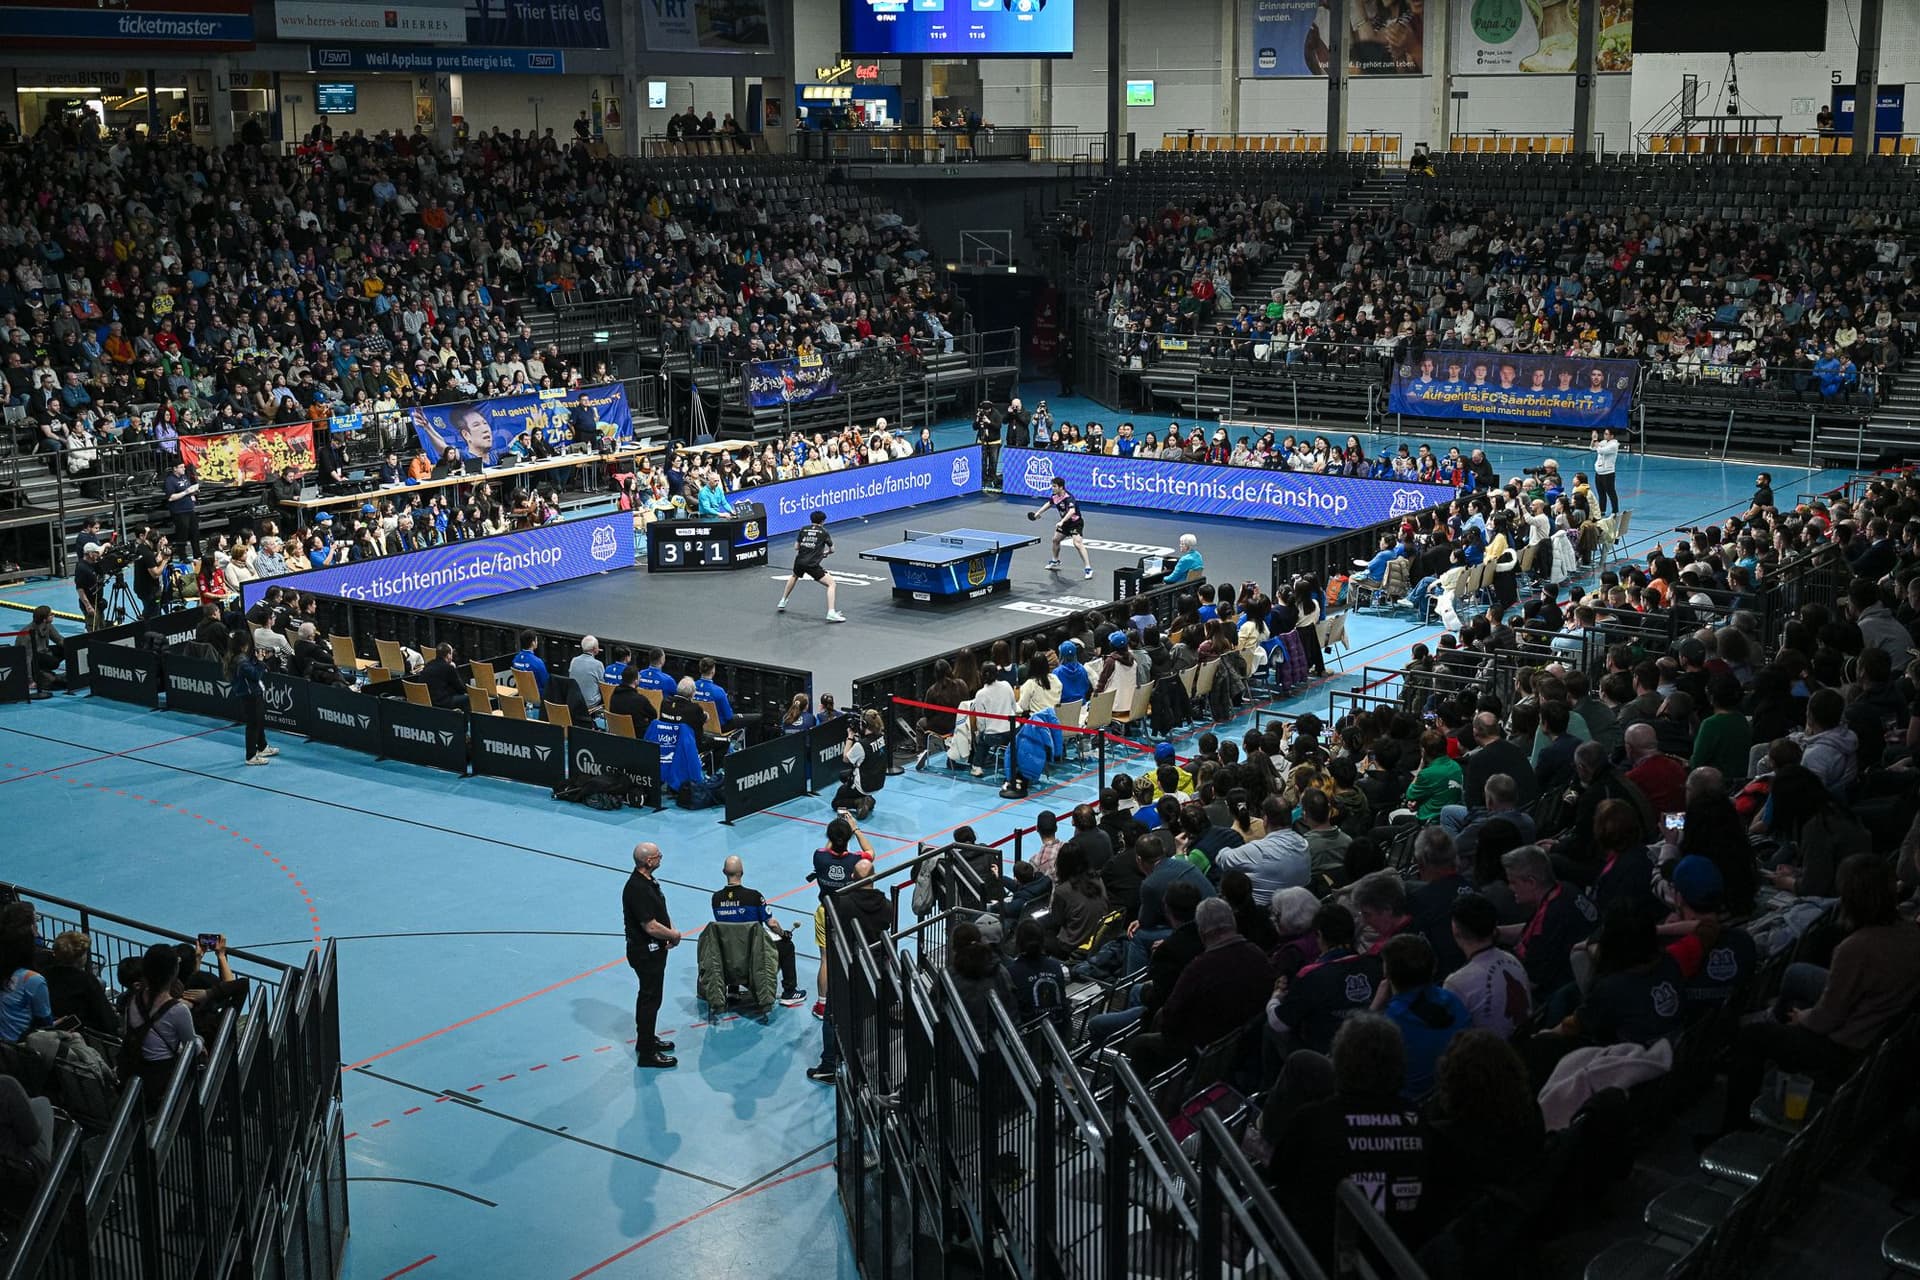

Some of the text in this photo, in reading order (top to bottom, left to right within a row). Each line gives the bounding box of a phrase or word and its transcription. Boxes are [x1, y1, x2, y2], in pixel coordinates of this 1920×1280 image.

[514, 4, 601, 22] Trier Eifel eG
[1259, 0, 1317, 13] Erinnerungen
[119, 15, 217, 36] ticketmaster
[281, 14, 449, 30] www.herres-sekt.com HERRES
[1474, 13, 1517, 31] Papa Lu
[329, 54, 349, 67] SWT
[366, 53, 389, 68] Weil
[392, 54, 433, 69] Applaus
[436, 57, 460, 71] pure
[461, 56, 500, 70] Energie
[500, 57, 517, 68] ist.
[1577, 74, 1589, 88] G
[1831, 70, 1842, 84] 5
[1422, 391, 1441, 402] Auf
[1481, 391, 1500, 403] FC
[1501, 393, 1574, 410] Saarbrücken
[1577, 402, 1595, 410] TT
[1463, 403, 1498, 414] Einigkeit
[1498, 406, 1525, 416] macht
[780, 471, 932, 516] fcs-tischtennis.de/fanshop
[1091, 467, 1349, 516] fcs-tischtennis.de/fanshop
[664, 541, 724, 563] 3 0 2 1
[340, 545, 562, 601] fcs-tischtennis.de/fanshop
[98, 664, 135, 683] TIBHAR
[168, 675, 215, 697] TIBHAR
[318, 707, 356, 728] TIBHAR
[393, 723, 437, 745] TIBHAR
[483, 739, 532, 760] TIBHAR
[737, 765, 780, 792] TIBHAR
[1345, 1113, 1402, 1127] TIBHAR
[1347, 1136, 1424, 1151] VOLUNTEER
